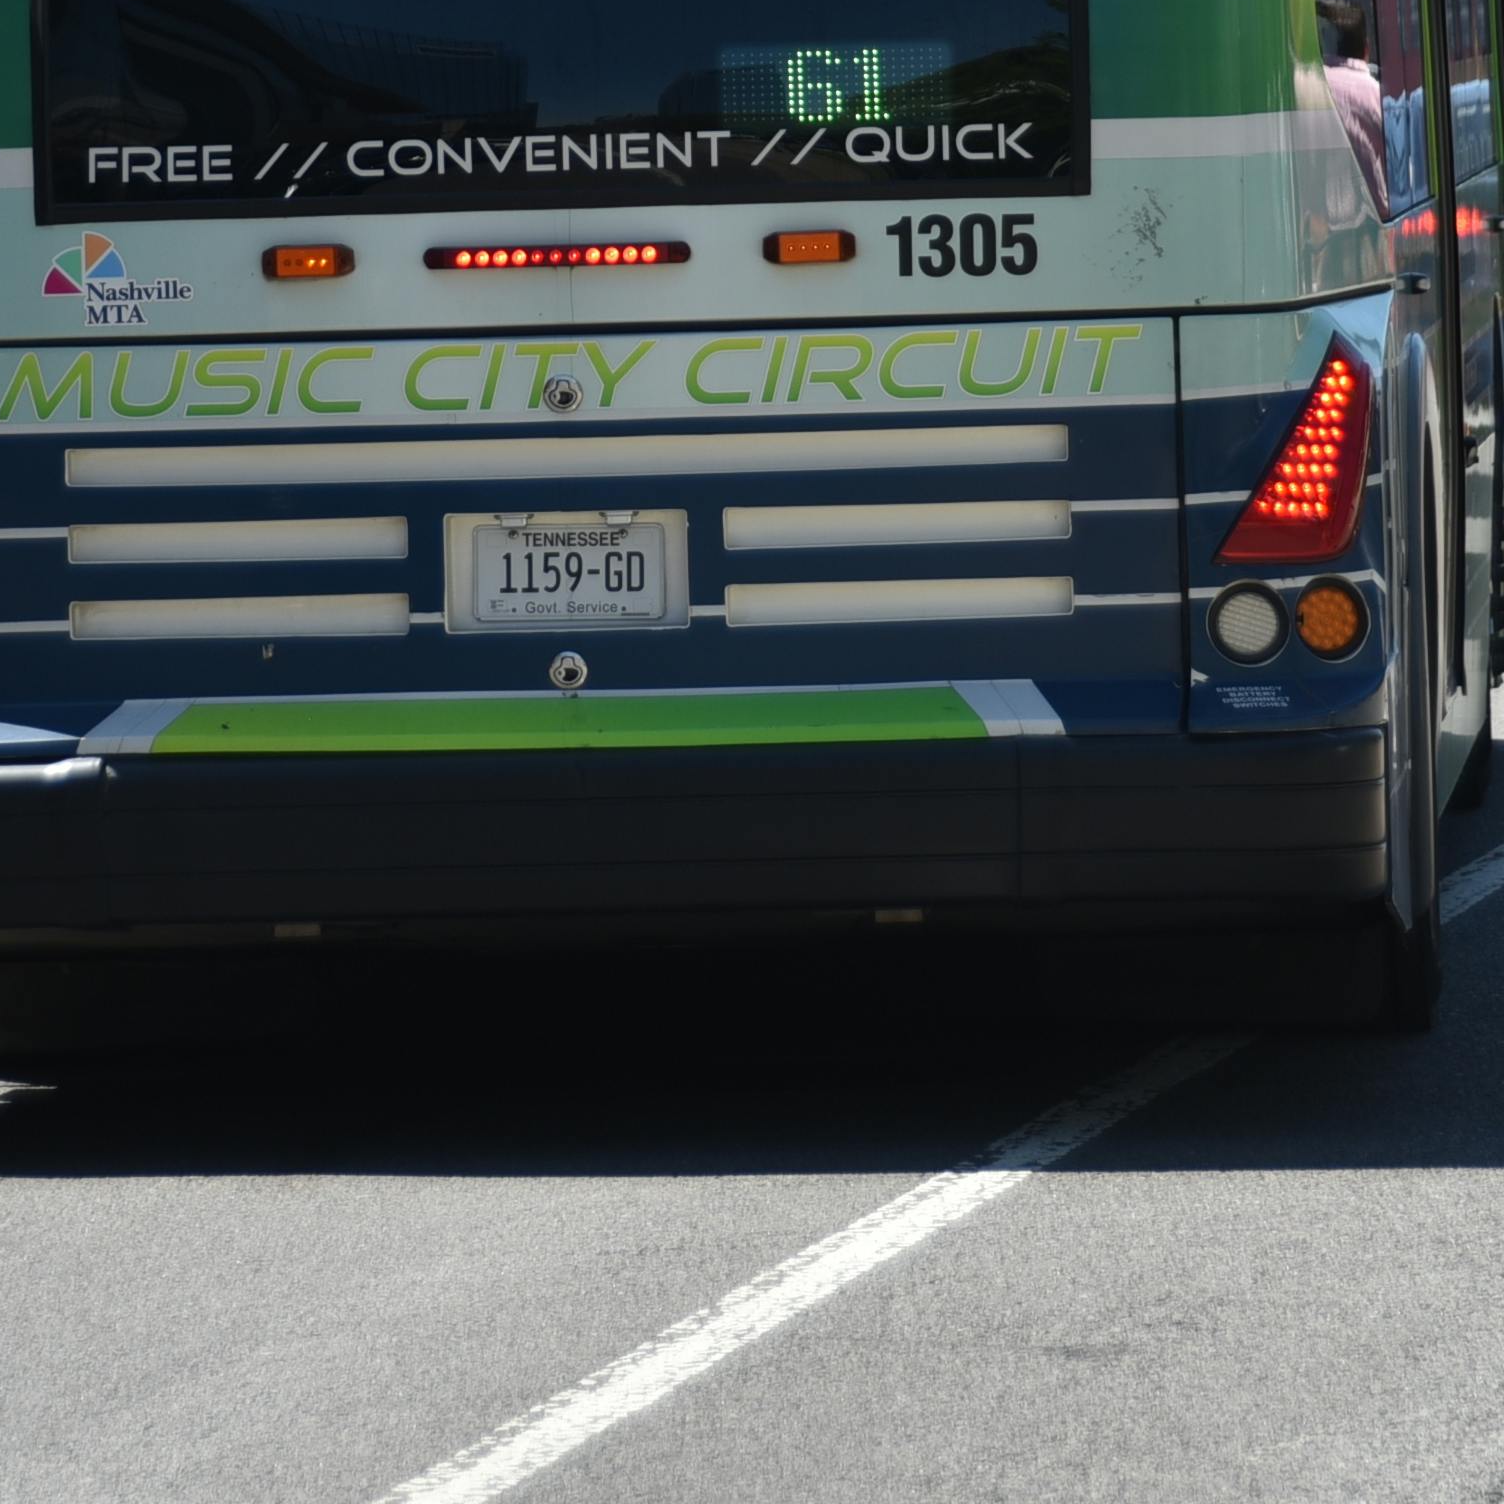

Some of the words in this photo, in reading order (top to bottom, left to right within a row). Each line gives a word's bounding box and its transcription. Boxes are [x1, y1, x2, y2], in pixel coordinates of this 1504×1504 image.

[787, 48, 892, 124] 61
[88, 144, 234, 183] FREE
[345, 130, 732, 177] CONVENIENT
[845, 122, 1035, 164] QUICK
[885, 213, 1038, 278] 1305
[86, 280, 192, 302] Nashville
[87, 304, 145, 324] MTA
[404, 338, 658, 411] CITY
[684, 324, 1143, 406] CIRCUIT
[522, 531, 620, 547] TENNESSEE
[499, 551, 645, 594] 1159-GD
[524, 601, 561, 614] Govt.
[567, 600, 618, 614] Service
[1216, 685, 1282, 693] EMERGENCY
[1221, 696, 1290, 704] DISCONNECT
